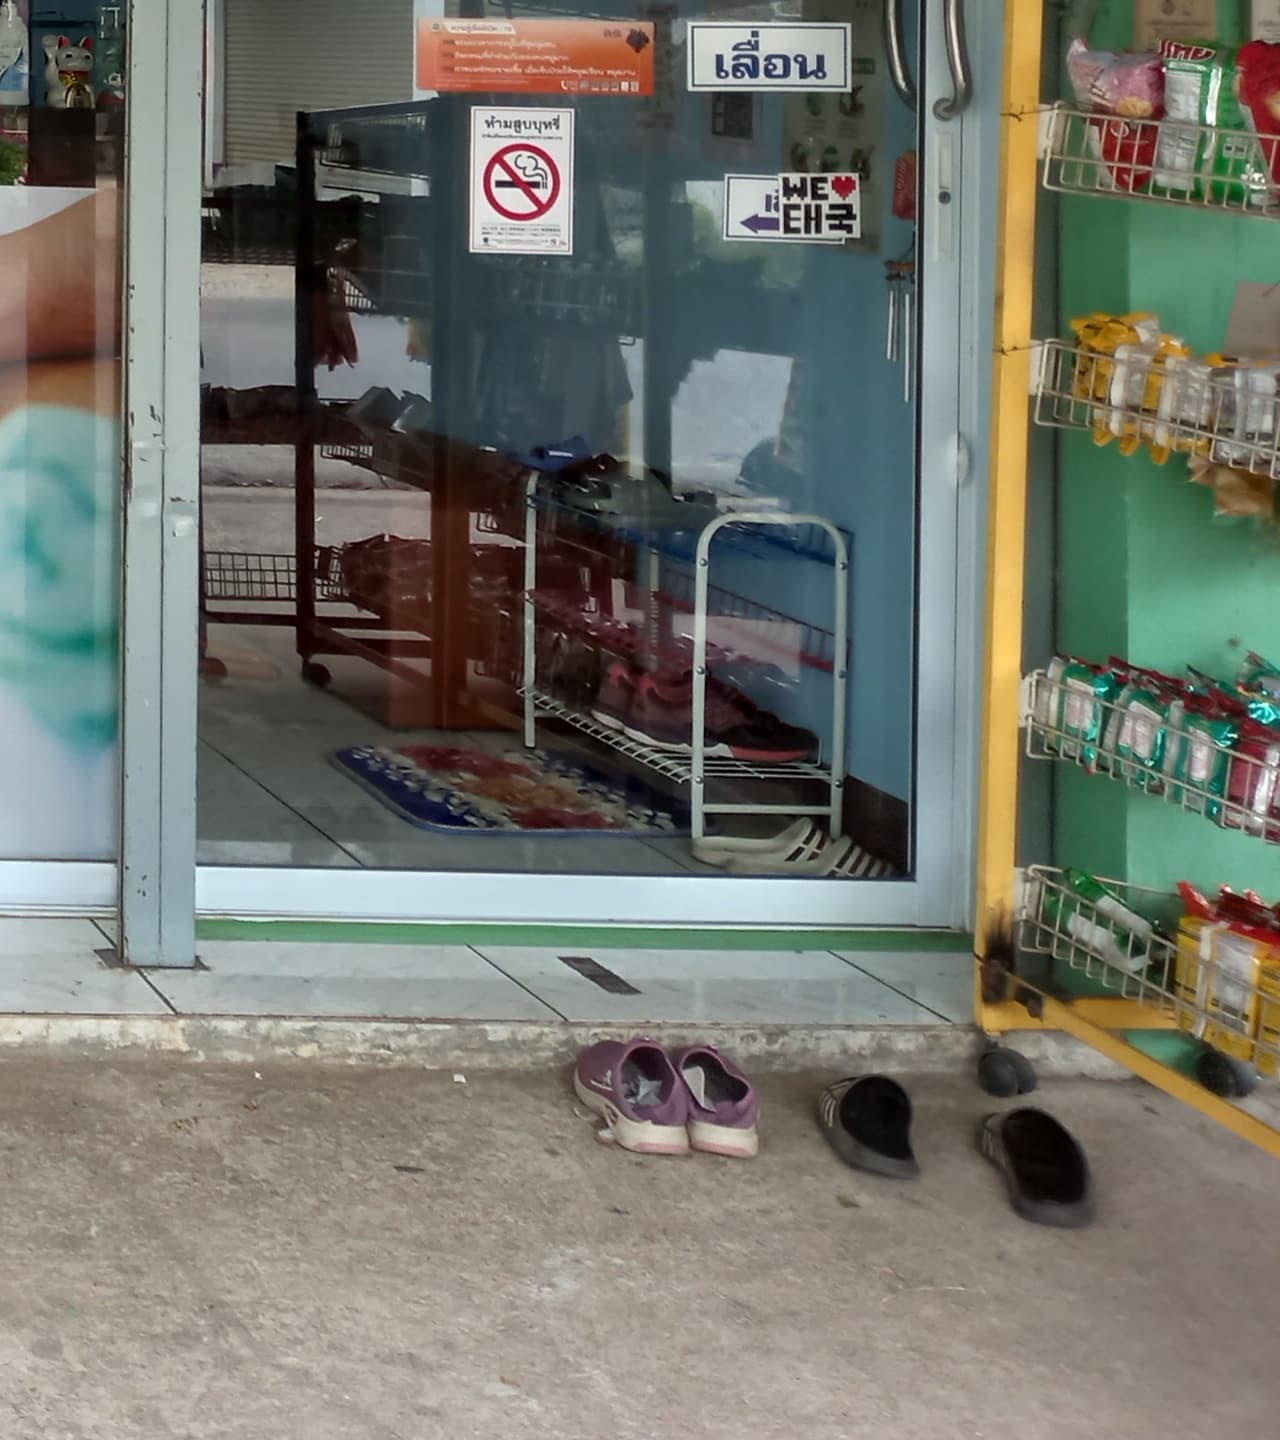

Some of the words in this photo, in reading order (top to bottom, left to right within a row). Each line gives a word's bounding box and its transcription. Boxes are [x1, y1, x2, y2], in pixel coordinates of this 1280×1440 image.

[715, 31, 827, 80] เลื่อน
[484, 114, 560, 134] ห้ามสูบบุหรี่
[782, 176, 829, 201] WE
